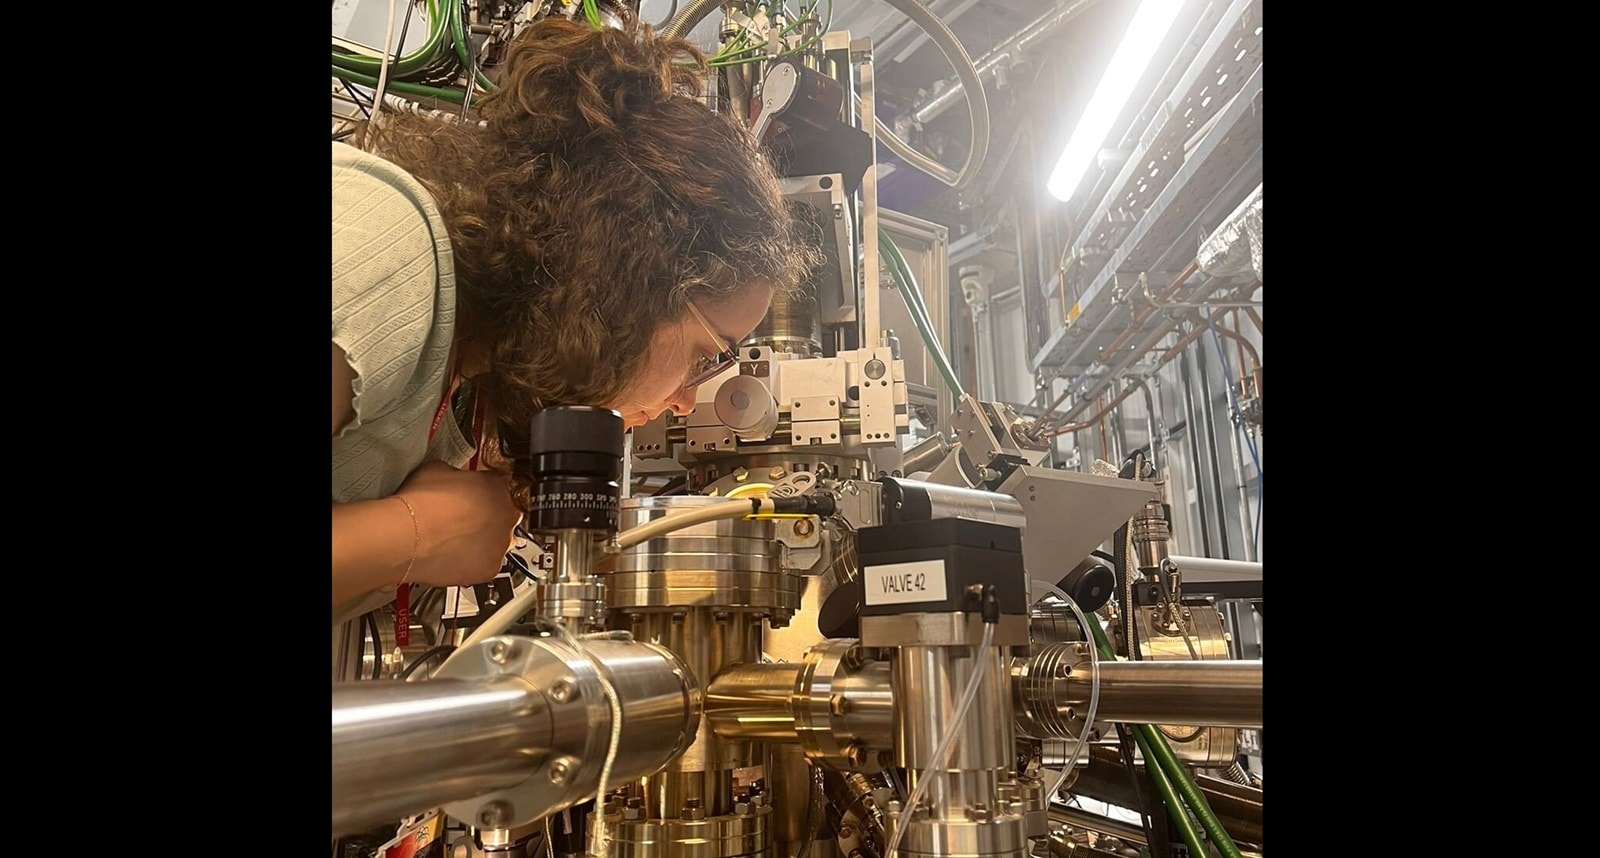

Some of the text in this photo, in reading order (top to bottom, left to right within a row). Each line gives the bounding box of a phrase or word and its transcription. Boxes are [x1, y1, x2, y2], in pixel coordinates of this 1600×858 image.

[750, 363, 759, 375] Y
[881, 573, 926, 593] VALVE 42
[398, 608, 408, 639] USER
